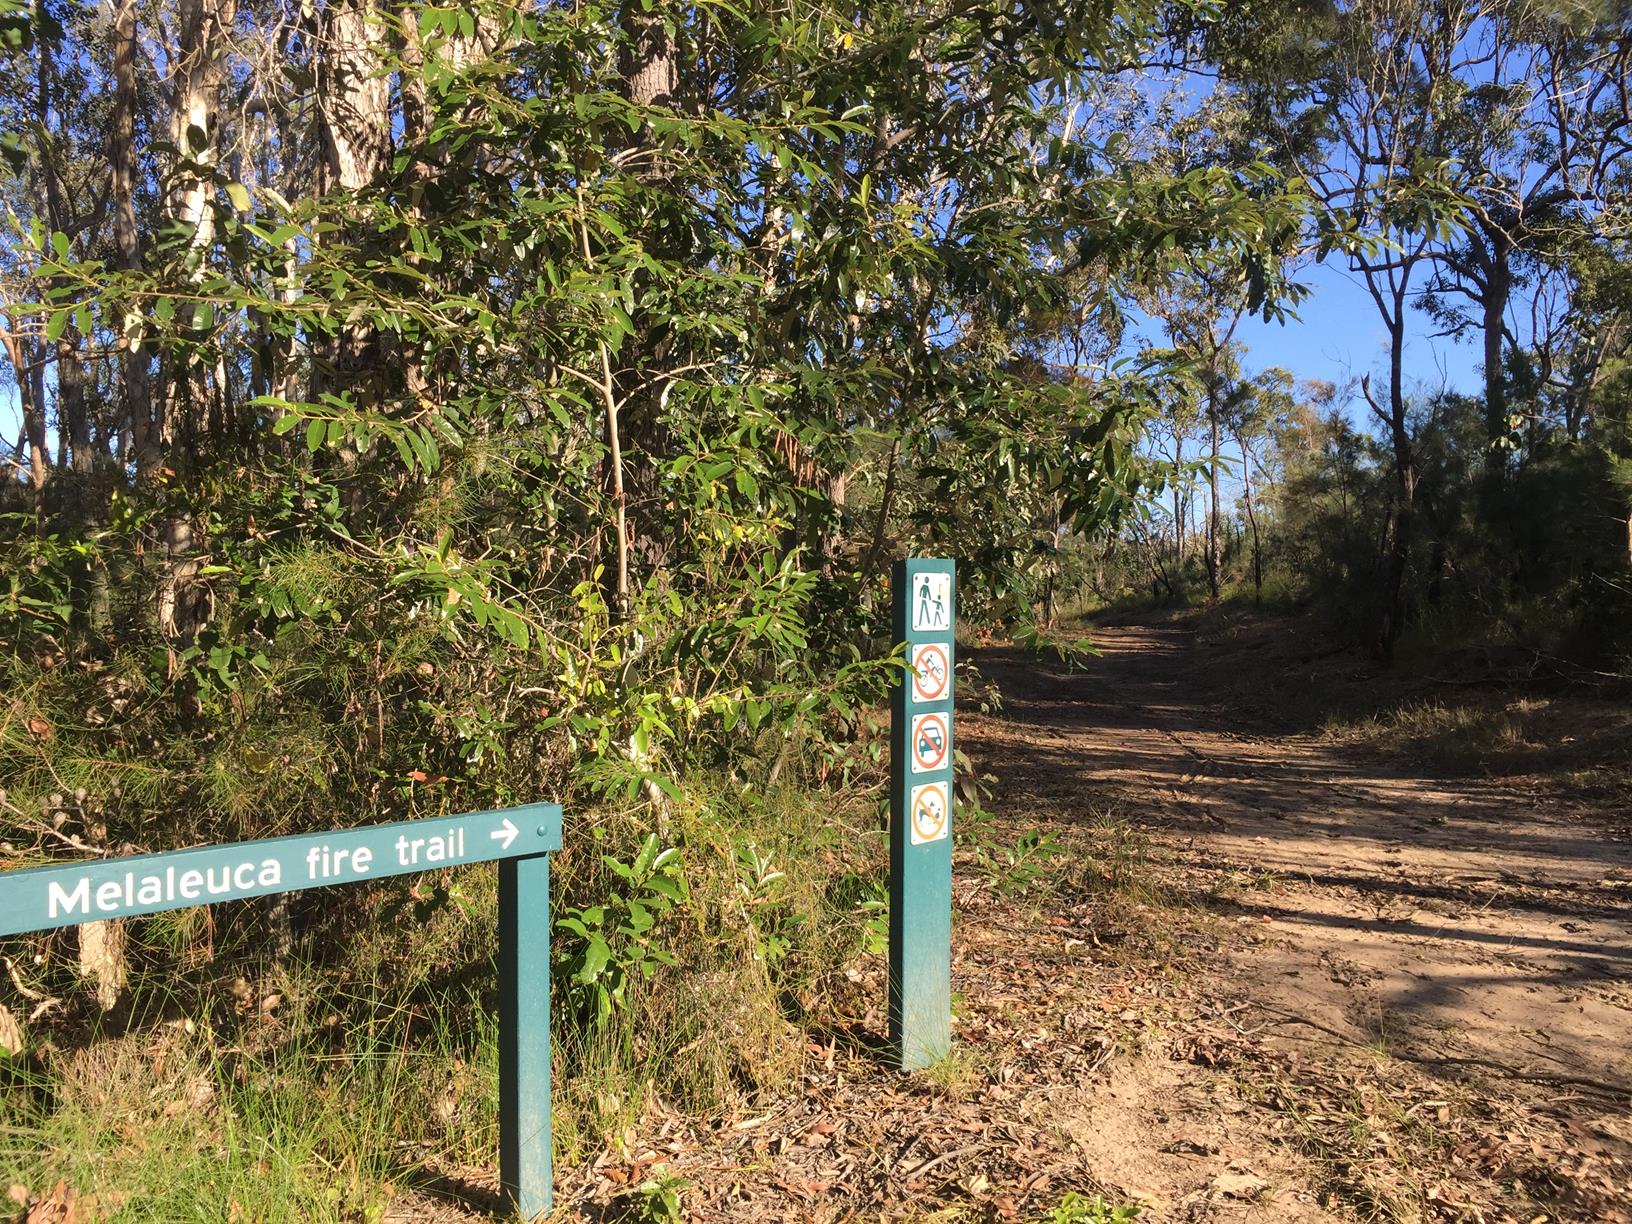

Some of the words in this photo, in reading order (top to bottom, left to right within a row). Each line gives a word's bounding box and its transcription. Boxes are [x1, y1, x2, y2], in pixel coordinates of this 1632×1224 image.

[47, 857, 282, 918] Melaleuca
[306, 845, 373, 879] fire
[395, 827, 466, 866] trail
